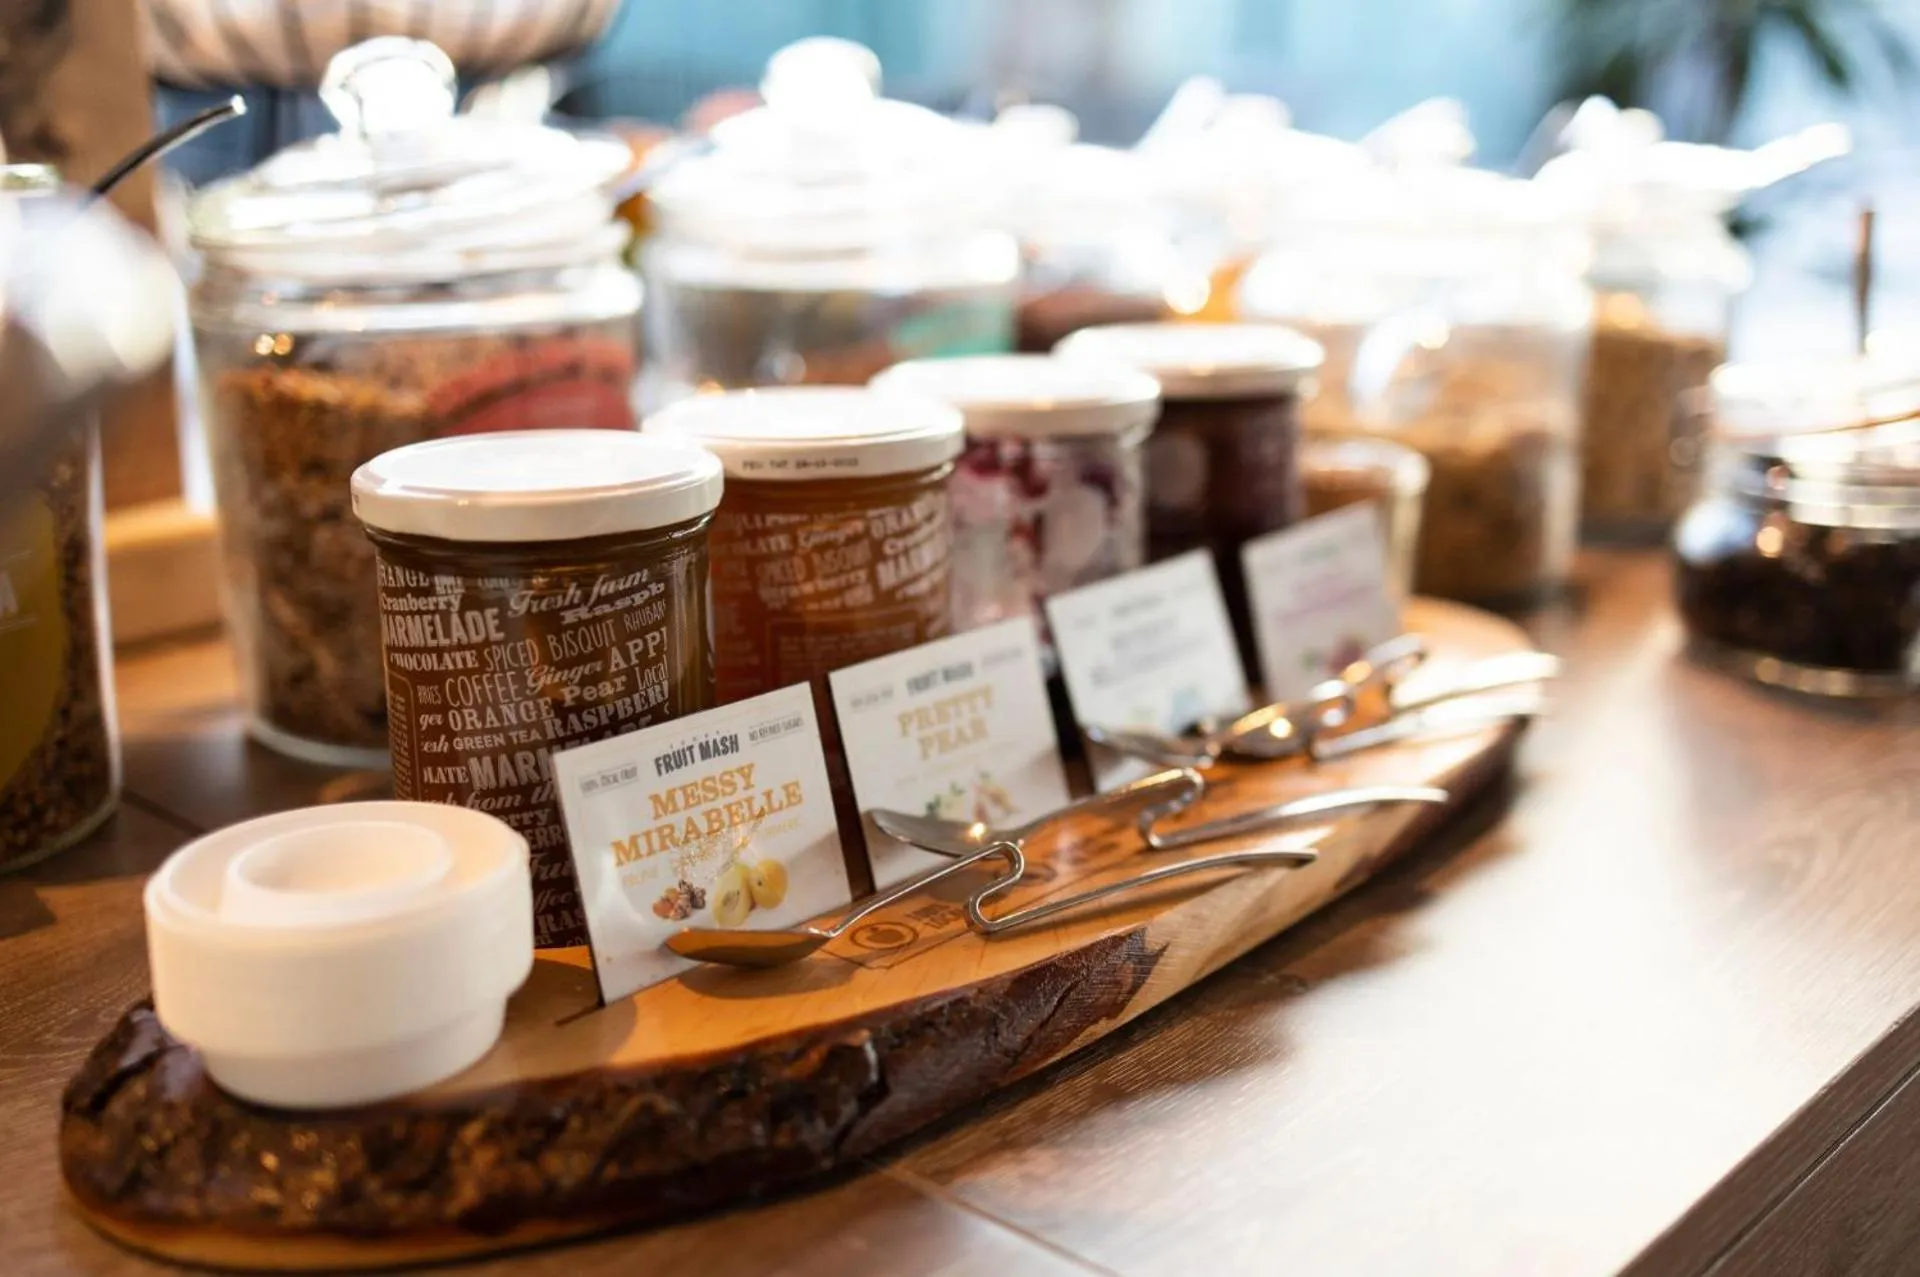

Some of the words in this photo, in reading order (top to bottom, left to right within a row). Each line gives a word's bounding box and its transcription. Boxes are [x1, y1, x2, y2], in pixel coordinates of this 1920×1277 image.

[507, 581, 582, 618] Fresh
[483, 638, 539, 671] SPICED
[547, 618, 616, 662] BISQUIT
[623, 600, 666, 634] RHUBAR
[445, 671, 522, 708] COFFEE
[525, 660, 604, 696] Ginger
[448, 697, 555, 732] ORANGE
[560, 674, 628, 708] Pear
[897, 682, 994, 738] PRETTY
[452, 733, 507, 751] GREEN
[508, 728, 542, 745] TEA
[654, 745, 696, 777] FRUIT
[698, 733, 740, 762] MASH
[916, 716, 991, 761] PEAR
[648, 762, 756, 821] MESSY
[610, 780, 805, 868] MIRABELLE
